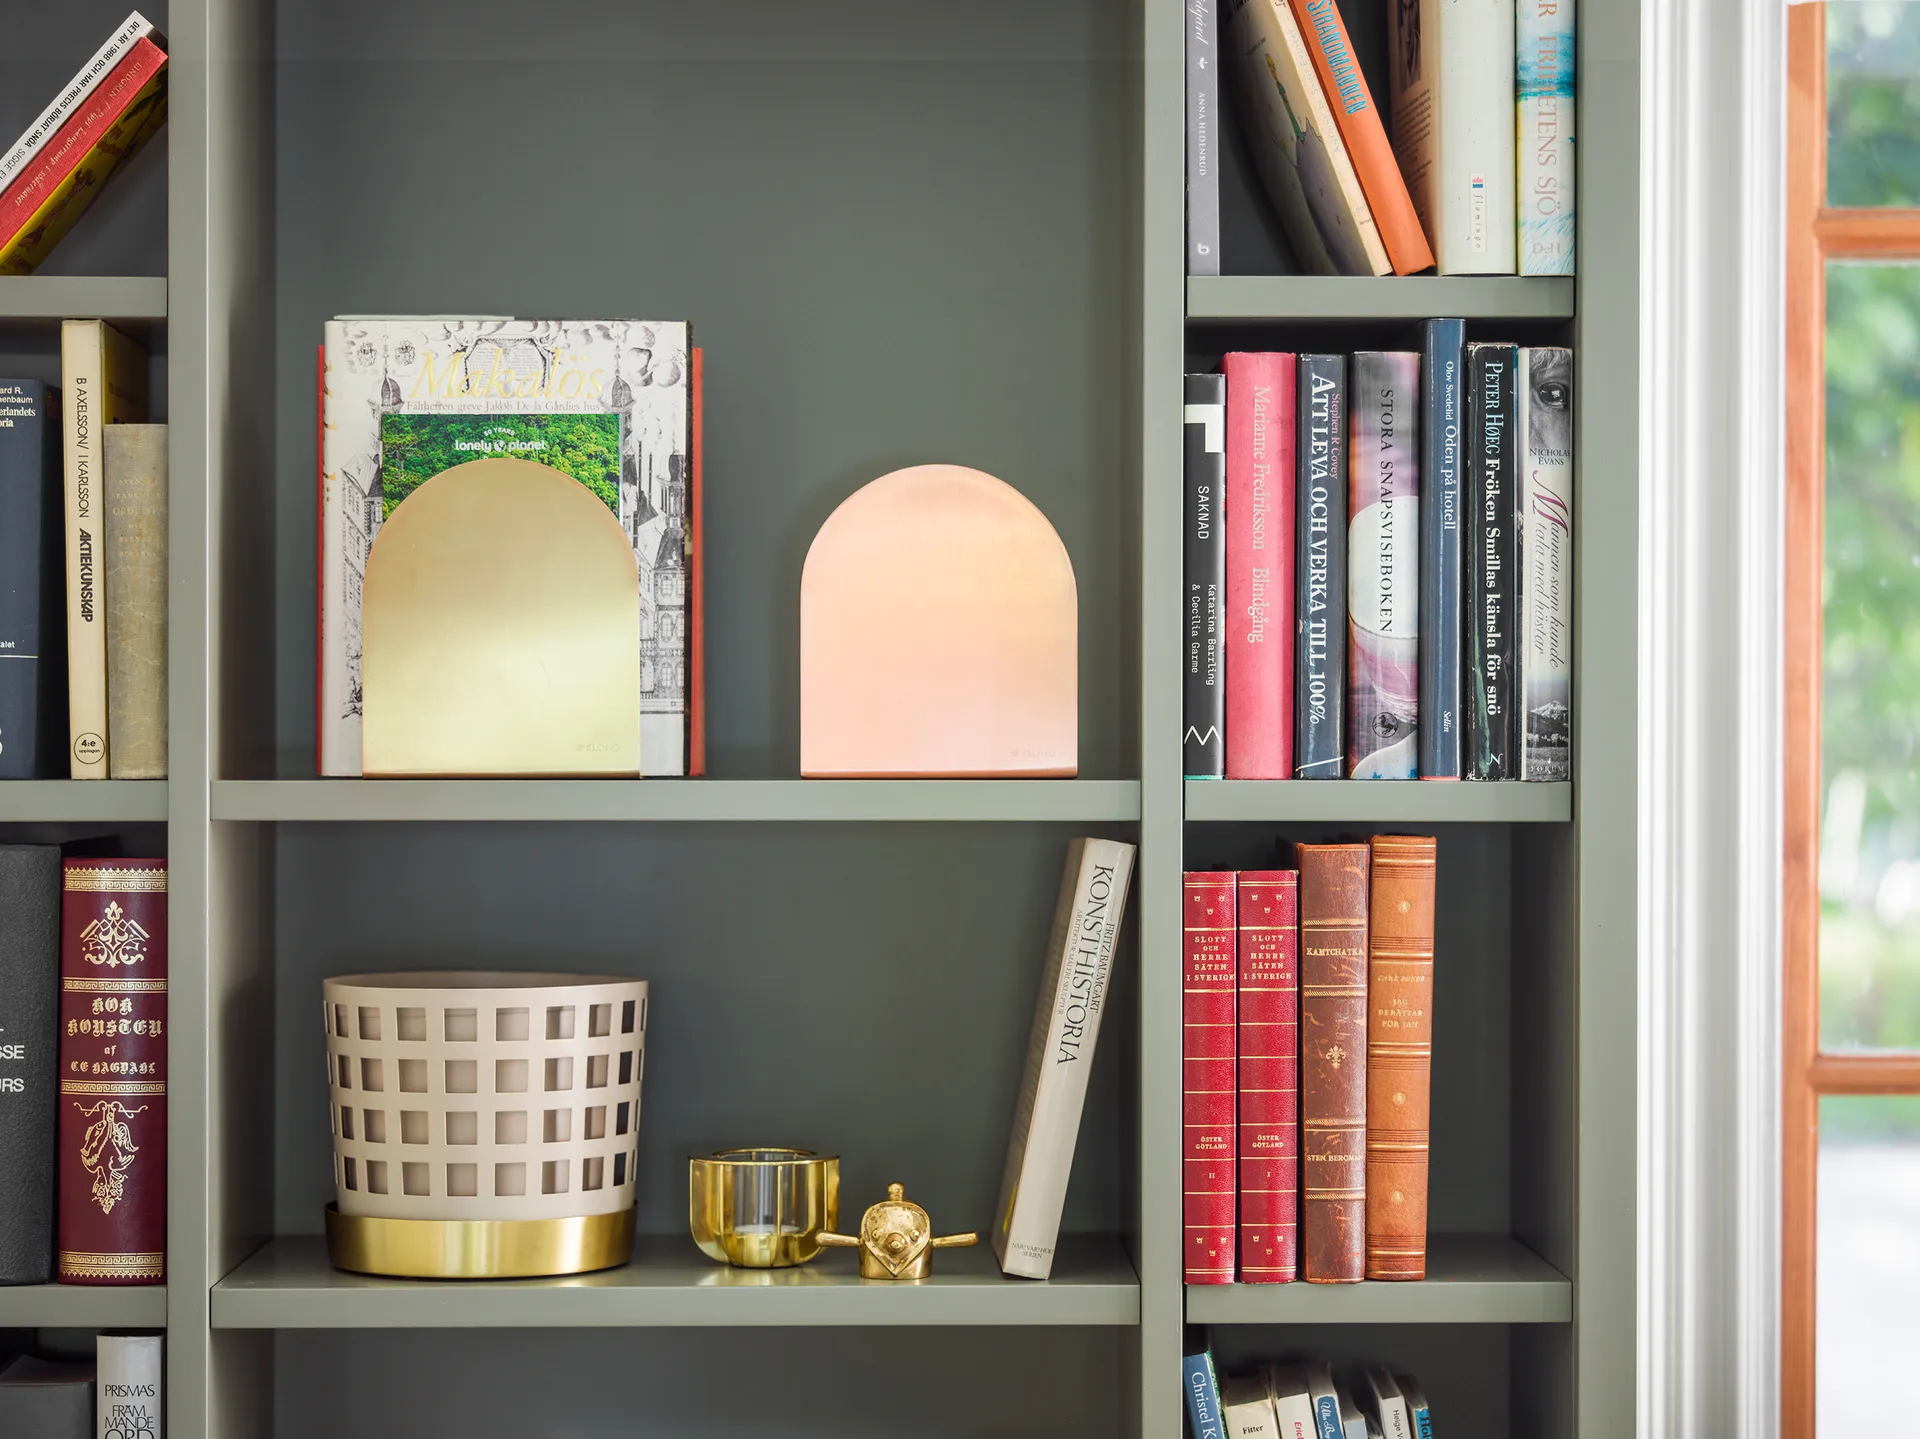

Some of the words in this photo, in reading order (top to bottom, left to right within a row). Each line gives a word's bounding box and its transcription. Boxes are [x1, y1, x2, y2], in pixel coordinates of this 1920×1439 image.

[118, 34, 130, 45] ÄR
[128, 21, 140, 35] DET
[91, 59, 106, 74] OCH
[103, 44, 120, 61] 1988
[60, 87, 81, 109] PRECIS
[80, 72, 94, 88] HAR
[41, 107, 63, 132] BÖRJAT
[1199, 93, 1207, 118] ANNA
[1538, 36, 1557, 166] FRIHETENS
[24, 129, 43, 149] SNÖA
[1198, 122, 1207, 176] HEDENRUD
[3, 148, 26, 171] SIGGE
[1535, 176, 1561, 216] SJÖ
[1472, 194, 1484, 248] flamingo
[408, 348, 605, 399] Makalös
[1445, 361, 1454, 382] Olov
[1485, 362, 1504, 409] PETER
[457, 402, 483, 413] greve
[517, 401, 531, 411] De
[534, 401, 542, 411] la
[583, 401, 601, 411] hus
[1312, 373, 1336, 422] ATT
[1330, 393, 1342, 434] Stephen
[1445, 384, 1454, 420] Svedelid
[1253, 386, 1270, 460] Marianne
[1381, 389, 1394, 452] STORA
[1484, 413, 1504, 454] HØEG
[455, 440, 492, 452] lonely
[508, 440, 546, 452] planet
[1311, 427, 1328, 480] LEVA
[1329, 447, 1341, 480] Covey
[1444, 425, 1460, 466] Öden
[1530, 448, 1570, 456] NICHOLAS
[1538, 457, 1564, 466] EVANS
[78, 462, 90, 518] KARLSSON
[1440, 466, 1456, 488] på
[1485, 458, 1500, 522] Fröken
[1198, 486, 1210, 540] SAKNAD
[1252, 464, 1270, 550] Fredriksson
[1310, 487, 1328, 532] OCH
[1444, 490, 1456, 530] hotell
[1532, 470, 1569, 572] Mannen
[1380, 461, 1394, 632] SNAPSVISEBOKEN
[1486, 528, 1501, 588] Smillas
[1535, 522, 1550, 556] tala
[79, 528, 93, 623] AKTIEKUNSKAP
[1309, 542, 1328, 614] VERKA
[1535, 558, 1550, 598] med
[1549, 576, 1560, 611] som
[1191, 595, 1201, 637] Cecilia
[1208, 584, 1217, 634] Katarina
[1247, 567, 1270, 644] Blindgång
[1486, 594, 1502, 648] känsla
[1309, 619, 1327, 666] TILL
[1534, 598, 1550, 656] hästar
[1550, 614, 1565, 668] kunde
[1191, 643, 1201, 674] Garme
[1206, 638, 1217, 686] Barrling
[1486, 654, 1502, 680] för
[1309, 671, 1326, 724] 100%
[1486, 685, 1501, 716] snö
[1102, 923, 1115, 953] FRITZ
[1306, 948, 1364, 956] KAMTCHATKA
[1057, 863, 1114, 1065] KONSTHISTORIA
[1089, 955, 1109, 1013] BAUMGART
[0, 1045, 24, 1059] SE
[0, 1078, 24, 1092] RS
[1196, 1142, 1227, 1150] GÖTLAND
[1328, 1154, 1363, 1162] BERGMAN
[104, 1384, 156, 1396] PRISMAS
[112, 1404, 146, 1416] FRÄM
[1191, 1372, 1210, 1425] Christel
[1202, 1426, 1217, 1439] K
[104, 1416, 154, 1428] MANDE
[1243, 1425, 1263, 1435] Fitter
[1390, 1409, 1403, 1431] Helge
